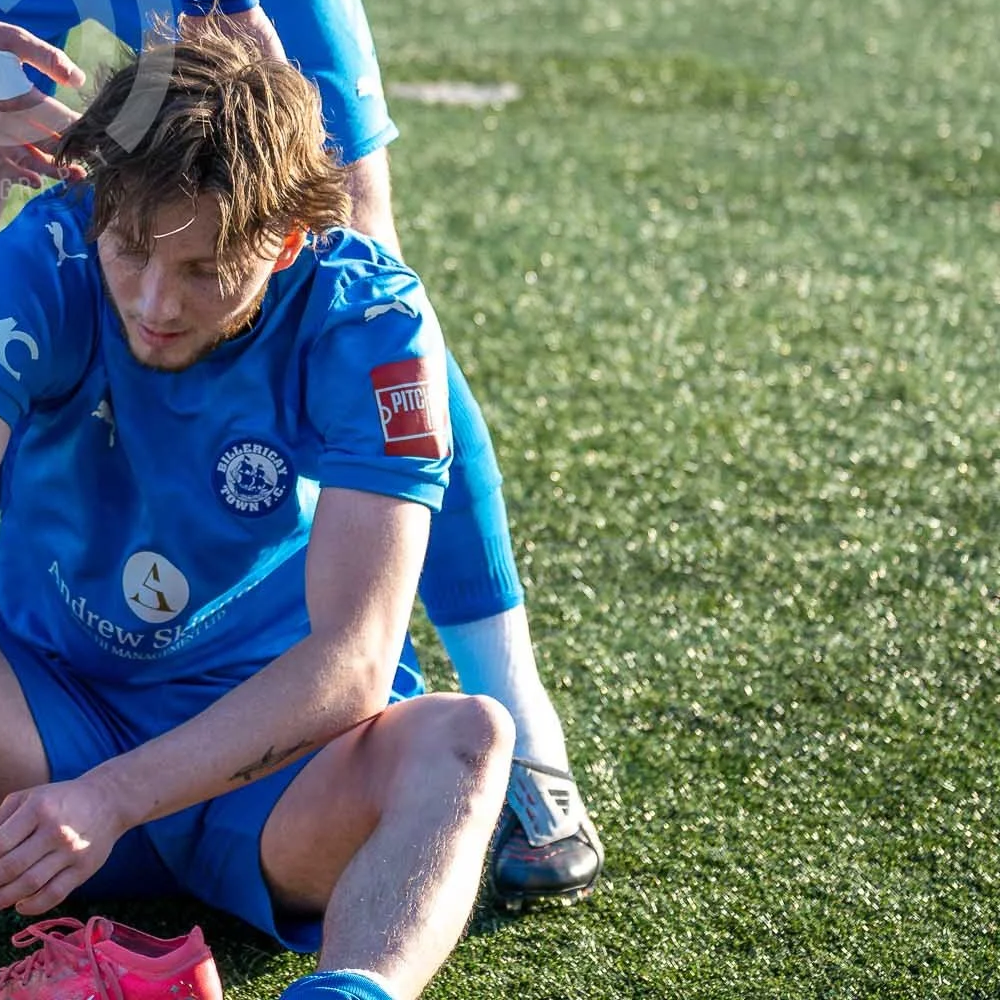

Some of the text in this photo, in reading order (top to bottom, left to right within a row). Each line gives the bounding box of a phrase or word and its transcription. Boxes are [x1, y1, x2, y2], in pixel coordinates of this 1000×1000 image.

[217, 443, 288, 475] BILLERICAY
[220, 484, 259, 512] TOWN
[47, 560, 145, 648] Andrew
